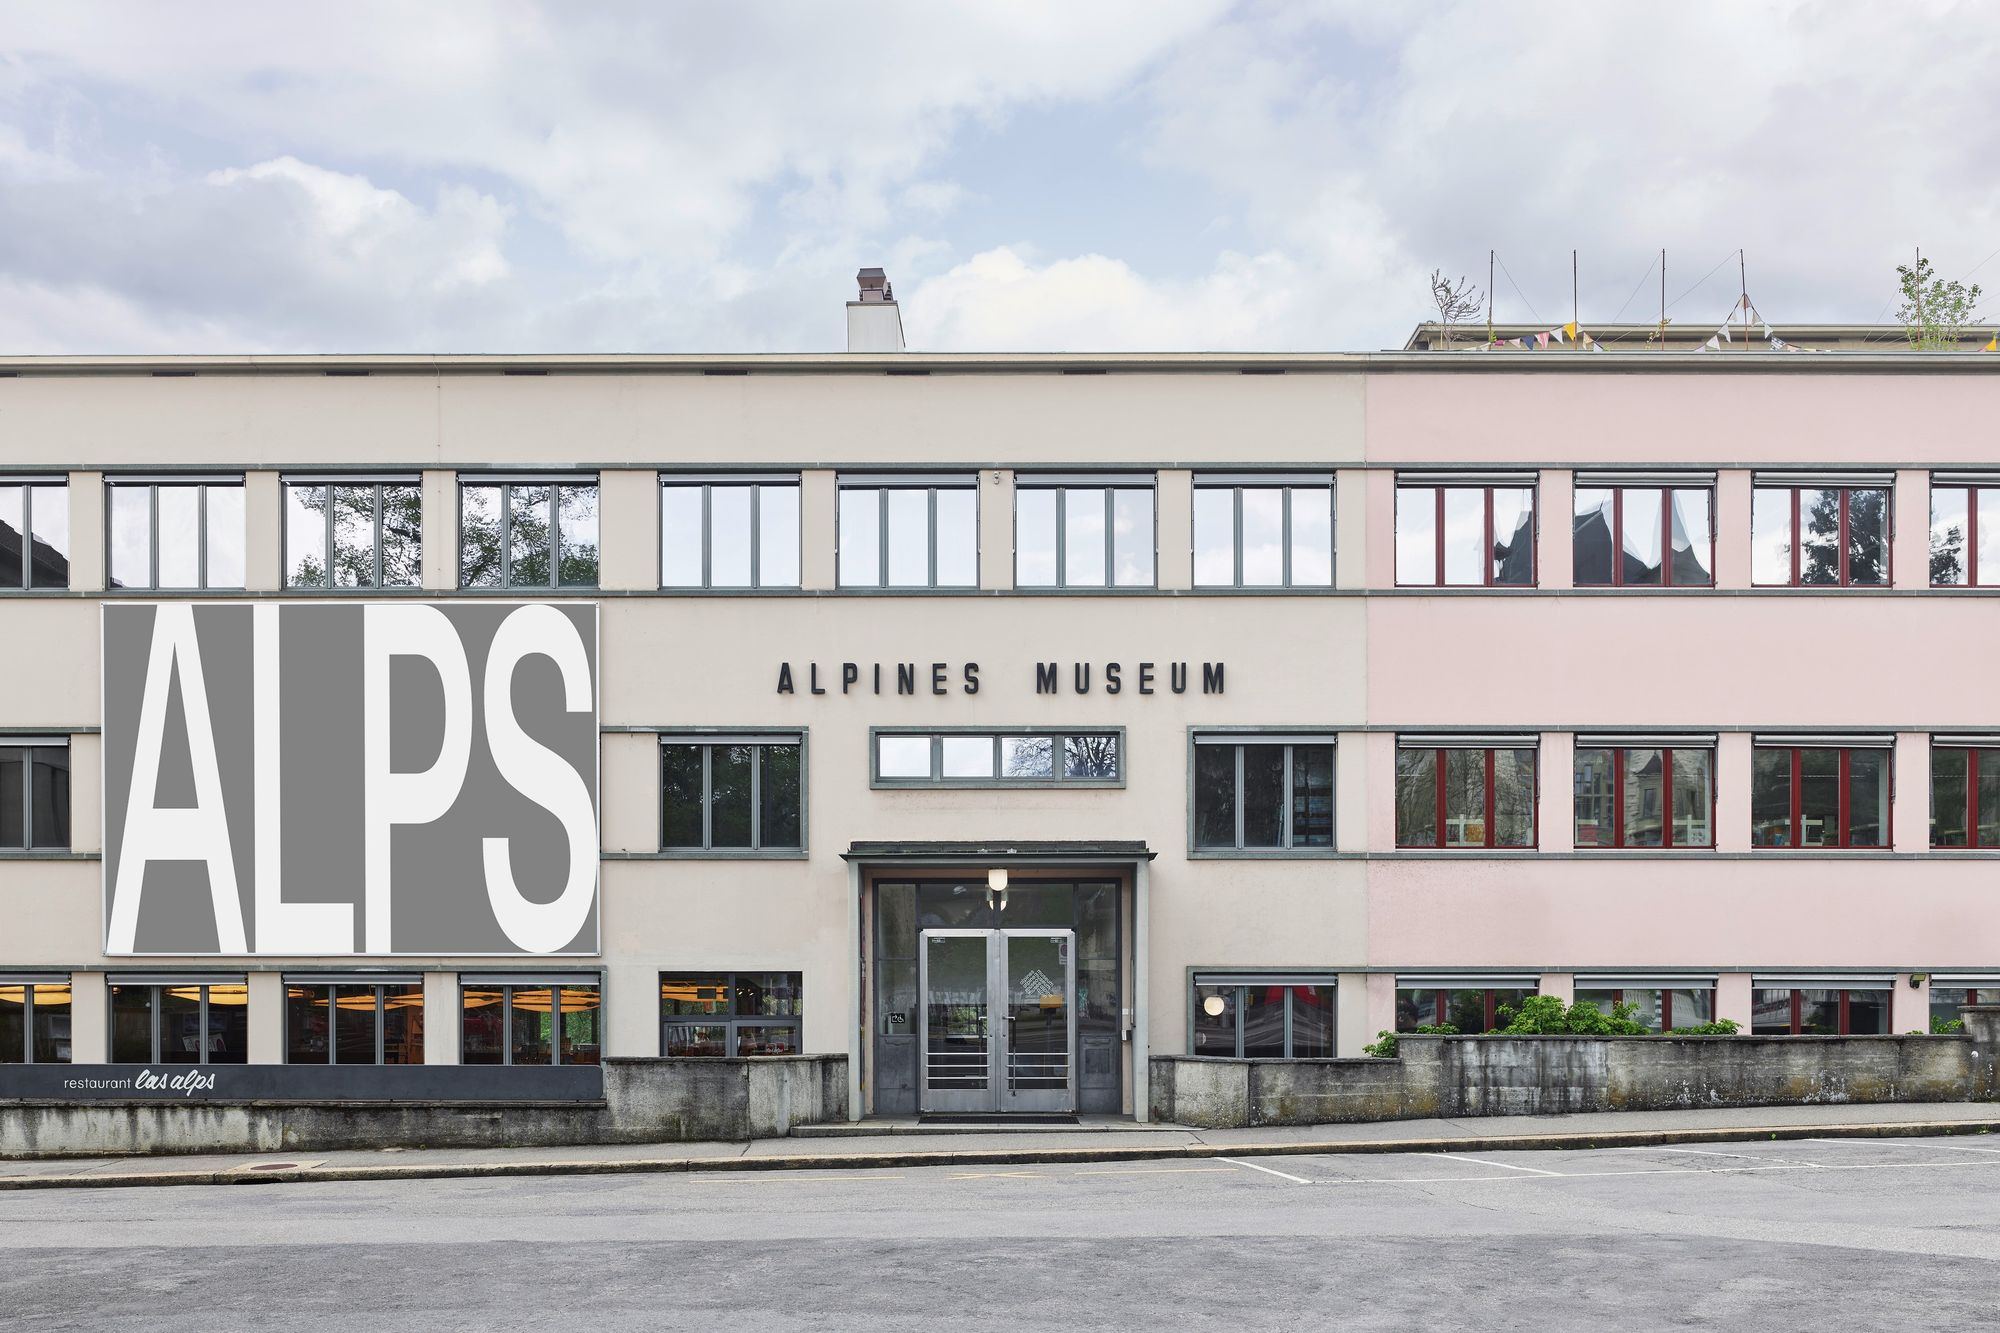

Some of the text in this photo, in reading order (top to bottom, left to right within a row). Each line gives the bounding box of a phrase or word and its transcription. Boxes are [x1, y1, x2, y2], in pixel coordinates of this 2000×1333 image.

[777, 662, 1225, 695] ALPINES MUSEUM
[107, 604, 597, 953] ALPS
[64, 1068, 216, 1097] restaurant las alps
